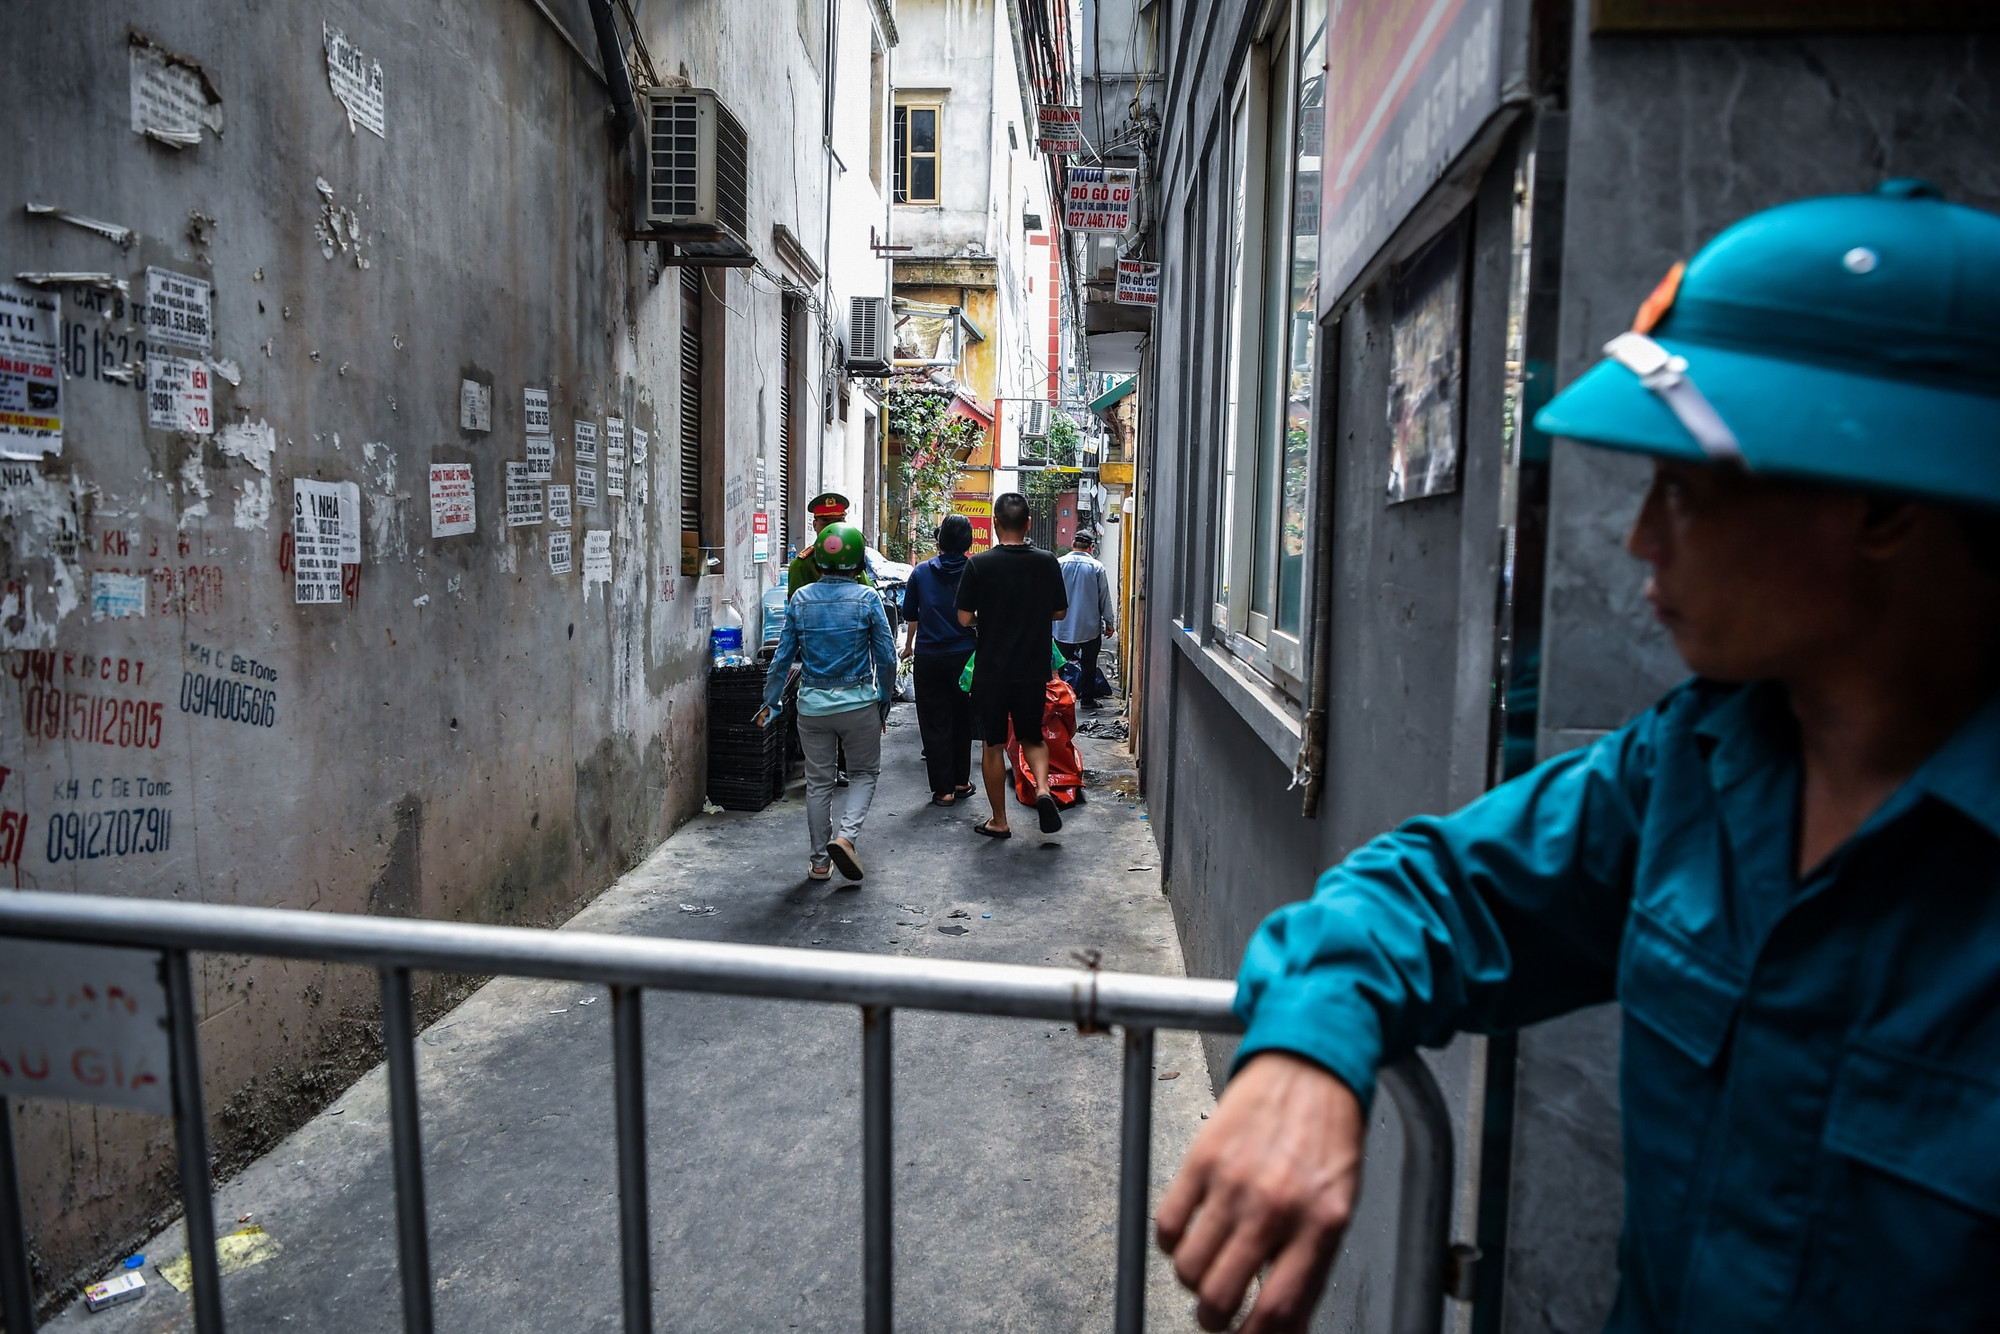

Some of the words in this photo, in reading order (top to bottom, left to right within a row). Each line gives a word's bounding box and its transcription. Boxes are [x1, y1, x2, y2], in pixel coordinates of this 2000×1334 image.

[1072, 169, 1104, 183] MUA
[1092, 183, 1109, 200] GỖ
[1113, 186, 1131, 201] CŨ
[1069, 212, 1128, 228] 037.446.7145
[319, 491, 339, 519] NHÀ
[972, 527, 988, 539] HỮA
[969, 541, 989, 554] ƯỜNG
[180, 672, 277, 728] 0914005616
[26, 685, 163, 749] 0915112605
[46, 807, 172, 863] 0912.707.911
